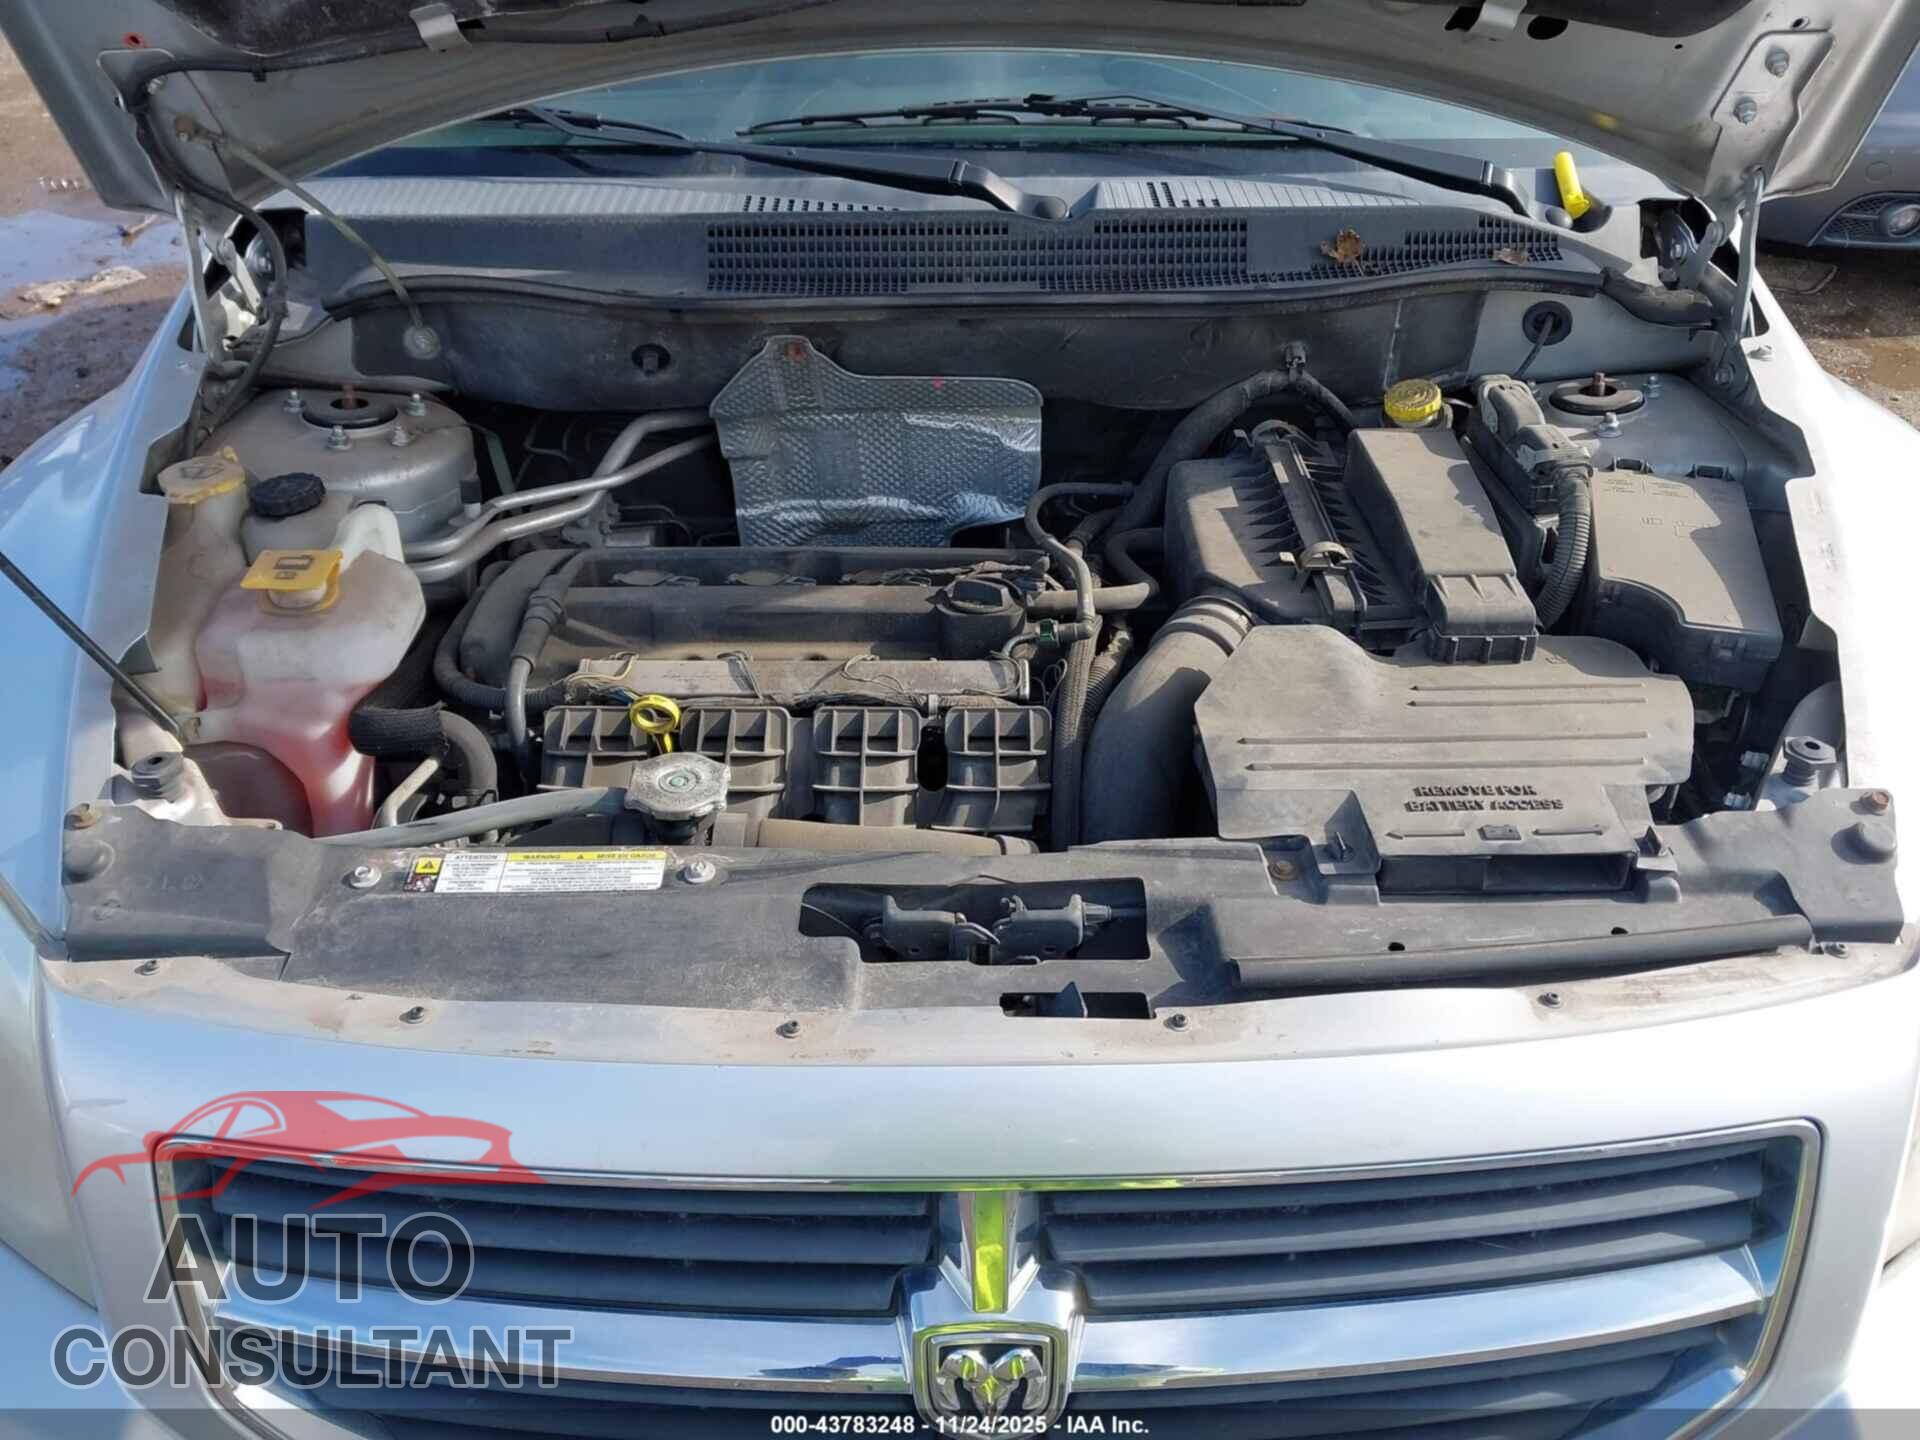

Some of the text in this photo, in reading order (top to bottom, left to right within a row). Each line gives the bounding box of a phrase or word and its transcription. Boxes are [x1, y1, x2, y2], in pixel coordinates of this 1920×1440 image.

[1412, 784, 1538, 797] REMOVE FOR
[1403, 799, 1564, 812] BATTERY ACCESS
